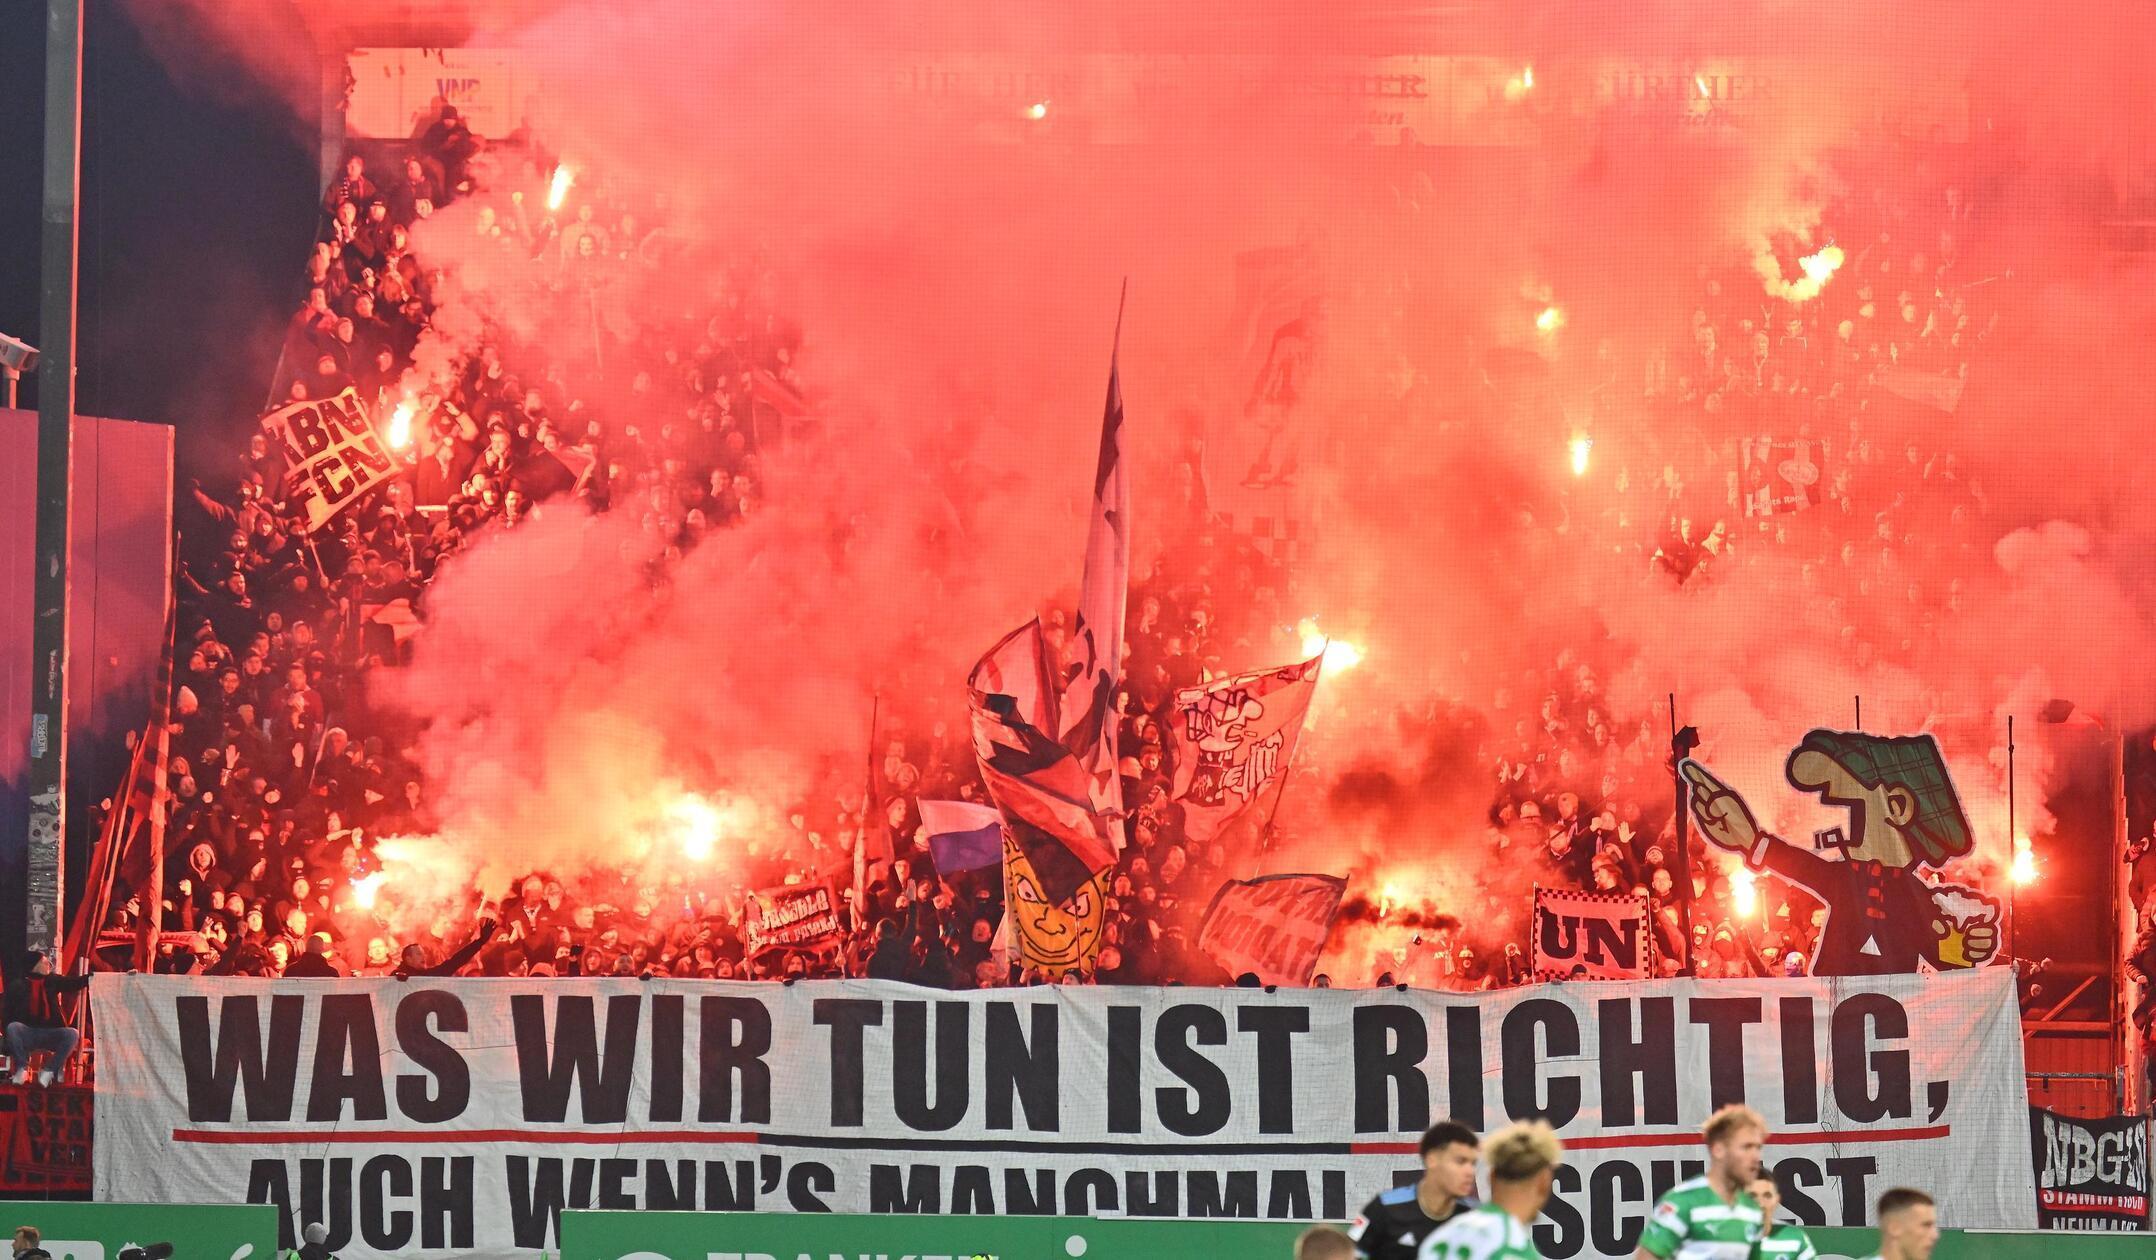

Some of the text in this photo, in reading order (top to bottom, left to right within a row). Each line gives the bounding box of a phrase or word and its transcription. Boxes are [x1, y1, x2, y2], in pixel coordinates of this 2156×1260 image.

[1540, 905, 1640, 970] UN
[176, 990, 1950, 1137] WAS WIR TUN IST RICHTIG,
[247, 1153, 475, 1252] AUCH
[1758, 1156, 1878, 1227] ST
